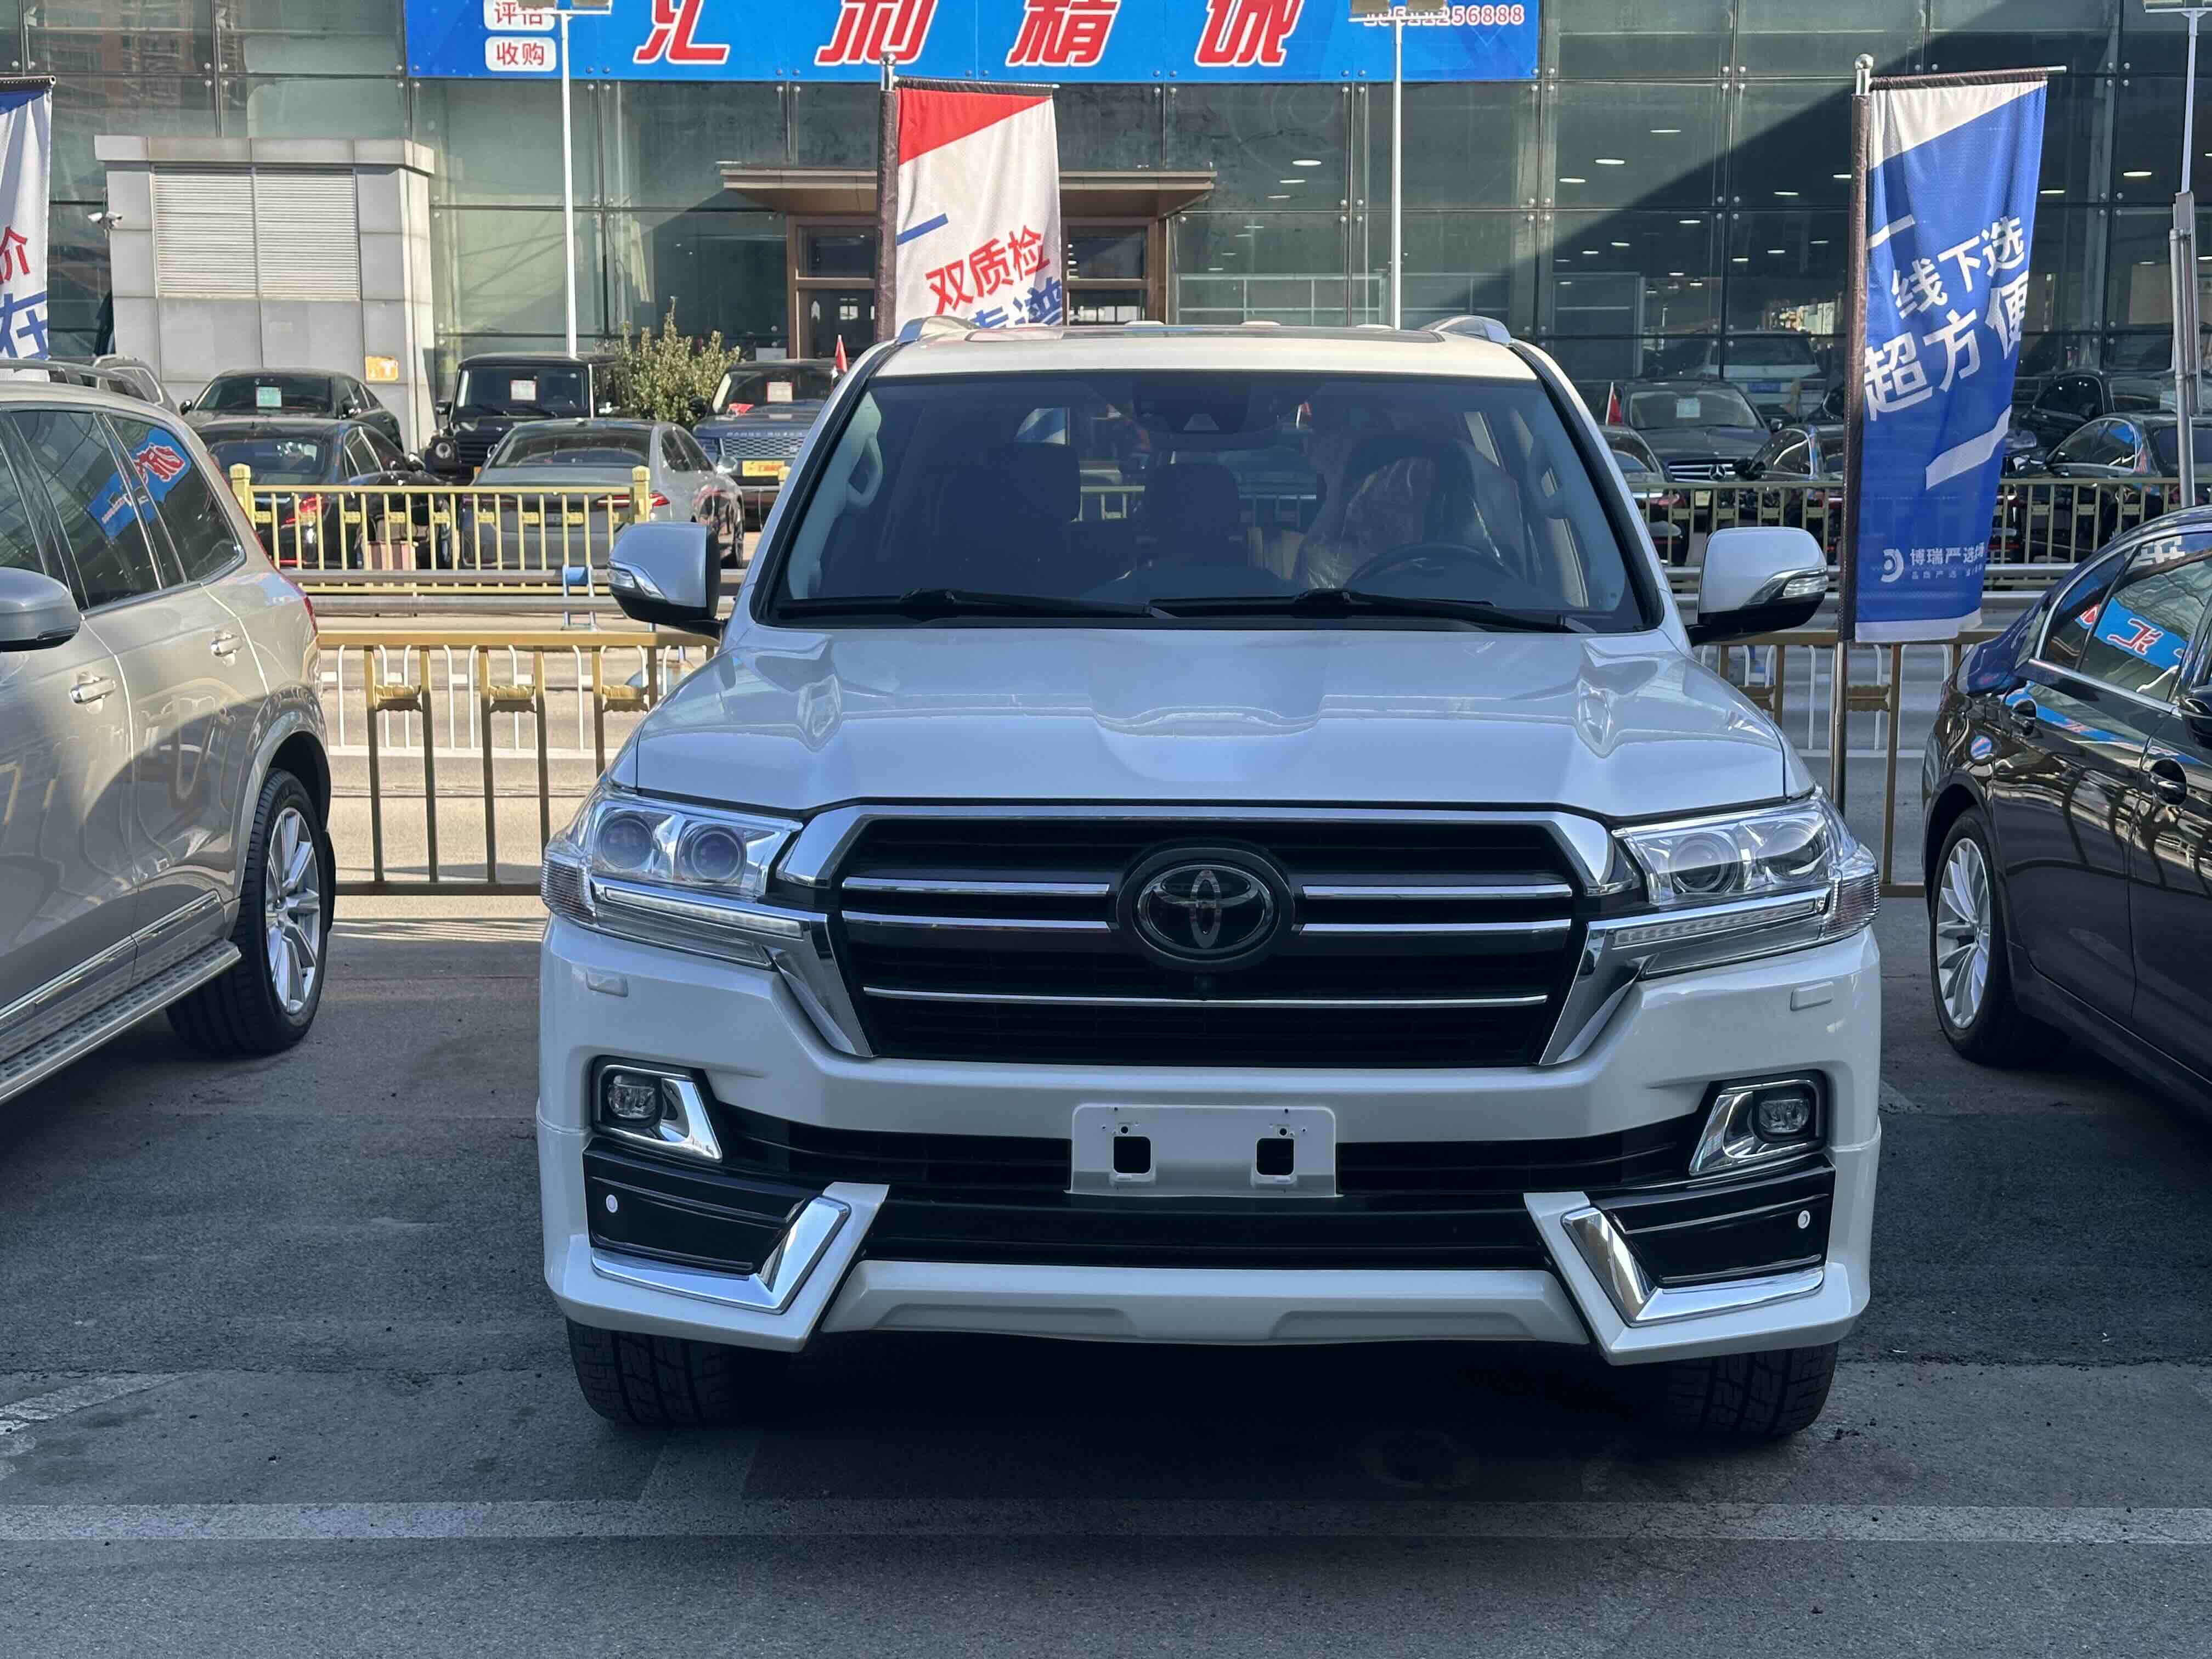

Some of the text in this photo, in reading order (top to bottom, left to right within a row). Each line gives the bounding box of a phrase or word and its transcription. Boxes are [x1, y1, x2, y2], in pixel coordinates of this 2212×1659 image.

[496, 42, 544, 65] 收购
[926, 225, 1050, 315] 双质检
[1891, 216, 2024, 319] 线下选
[1865, 270, 2029, 421] 超方便
